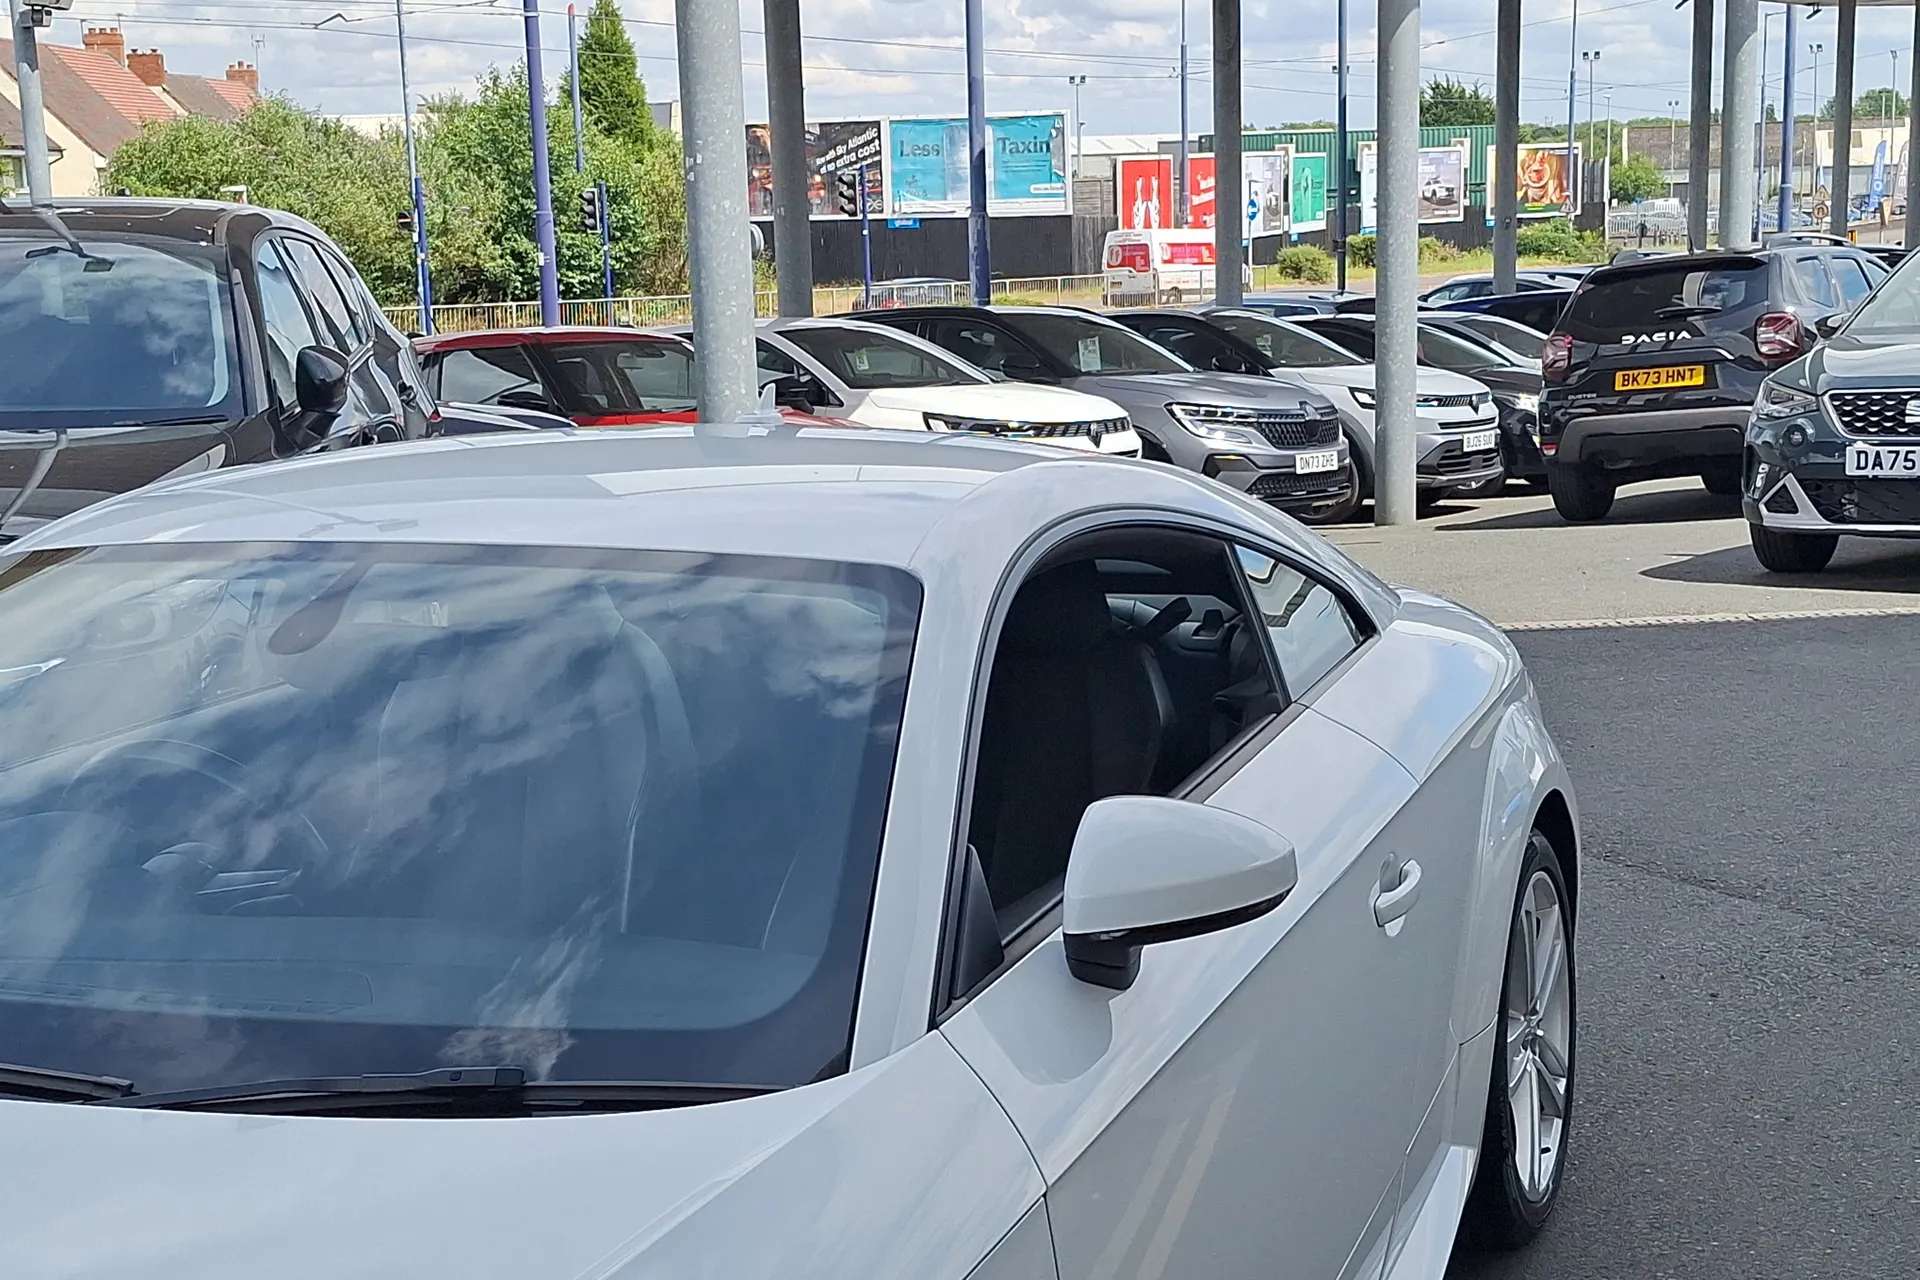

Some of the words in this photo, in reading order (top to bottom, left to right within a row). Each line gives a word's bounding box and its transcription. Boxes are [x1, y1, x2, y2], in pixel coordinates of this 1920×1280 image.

[836, 145, 847, 155] Sky
[848, 127, 878, 150] Atlantic
[900, 139, 940, 157] Less
[836, 152, 857, 168] extra
[857, 139, 880, 158] cost
[1621, 330, 1692, 345] DACIA
[1621, 371, 1662, 387] BK73
[1665, 368, 1697, 384] HNT
[1855, 450, 1917, 471] DA75
